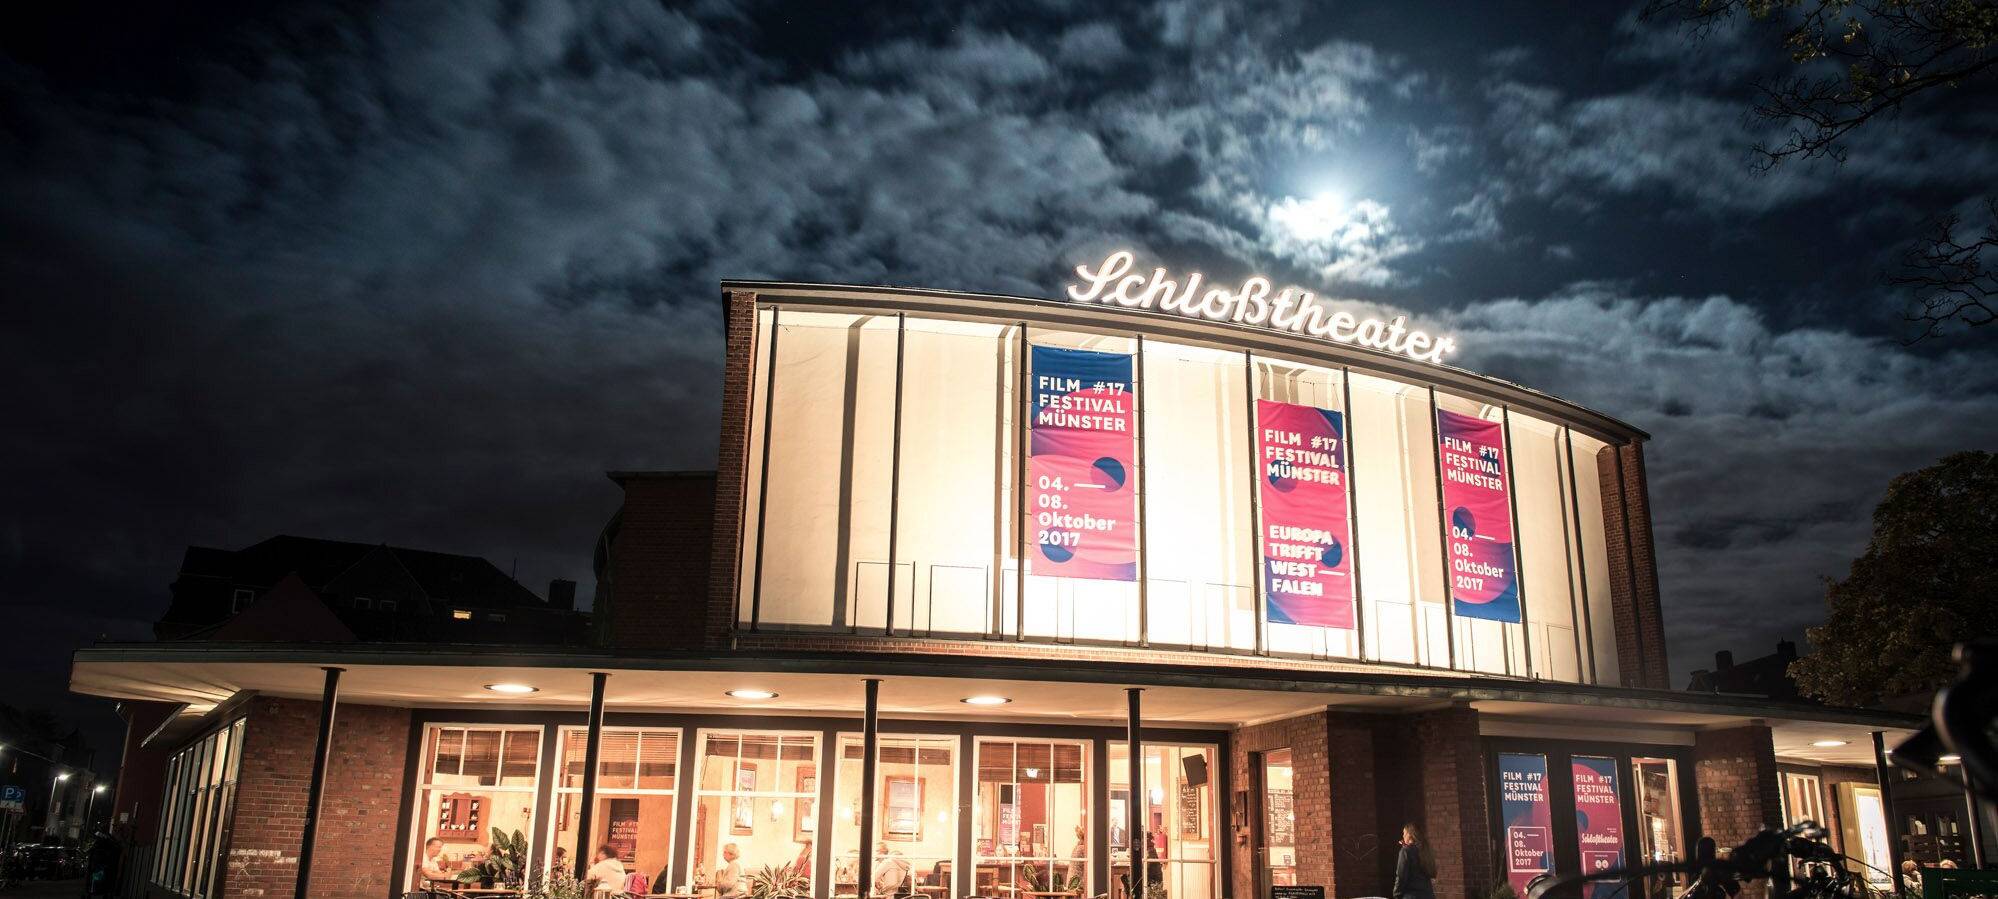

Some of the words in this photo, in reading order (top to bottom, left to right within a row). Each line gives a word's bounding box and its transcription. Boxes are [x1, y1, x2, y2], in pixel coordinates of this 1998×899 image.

[1067, 250, 1455, 364] Schloßtheater
[1039, 376, 1080, 392] FILM
[1093, 381, 1125, 396] #17
[1039, 393, 1125, 414] FESTIVAL
[1039, 409, 1126, 432] MÜNSTER
[1265, 429, 1301, 446] FILM
[1310, 435, 1337, 451] #17
[1444, 436, 1472, 454] FILM
[1479, 445, 1499, 460] #17
[1265, 446, 1339, 468] FESTIVAL
[1445, 452, 1501, 475] FESTIVAL
[1266, 461, 1340, 485] MÜNSTER
[1447, 467, 1503, 491] MÜNSTER
[1038, 493, 1068, 509] 08.
[1038, 511, 1116, 531] Oktober
[1038, 530, 1080, 546] 2017
[1269, 524, 1333, 545] EUROPA
[1269, 542, 1324, 562] TRIFFT
[1453, 542, 1473, 557] 08.
[1270, 560, 1317, 578] WEST
[1454, 558, 1504, 578] Oktober
[1272, 578, 1323, 596] FALEN
[1456, 575, 1483, 591] 2017
[1504, 772, 1522, 781] FILM
[1527, 773, 1542, 781] #17
[1575, 774, 1594, 783] FILM
[1598, 775, 1612, 783] #17
[1504, 782, 1543, 791] FESTIVAL
[1576, 785, 1614, 794] FESTIVAL
[1505, 791, 1544, 802] MÜNSTER
[1577, 792, 1615, 804] MÜNSTER
[1513, 840, 1526, 848] 08.
[1514, 849, 1544, 857] Oktober
[1514, 858, 1532, 866] 2017
